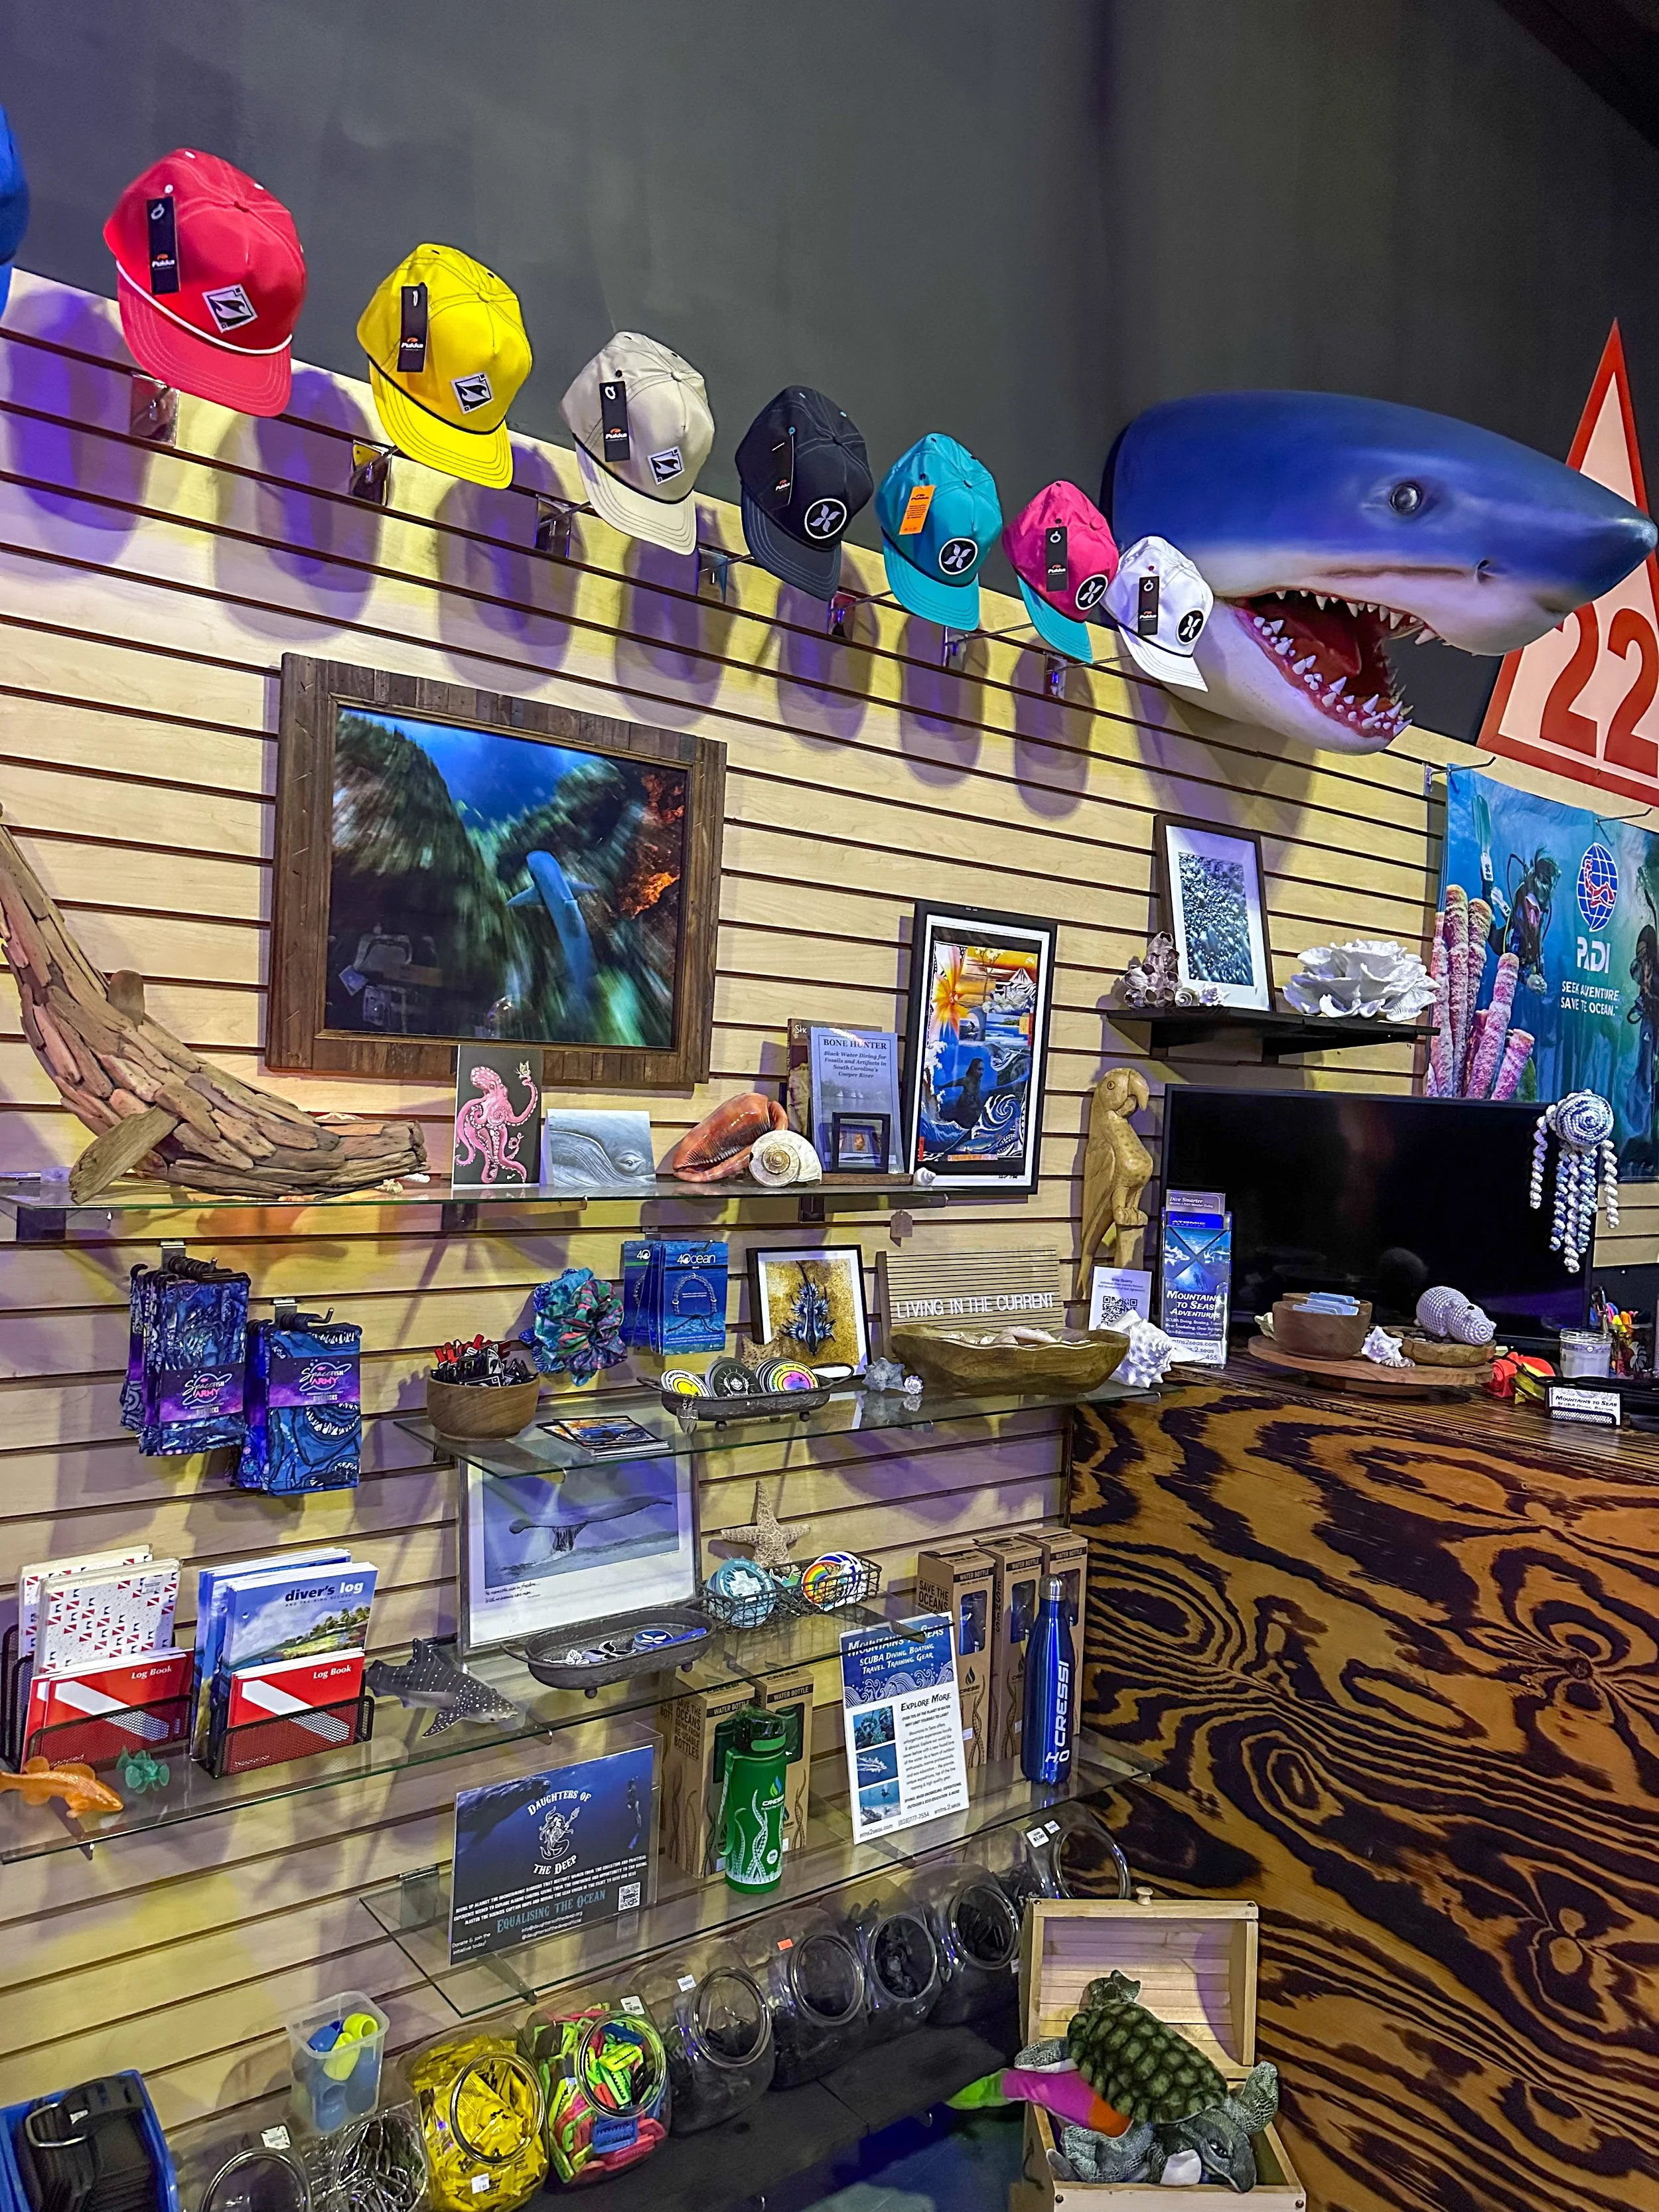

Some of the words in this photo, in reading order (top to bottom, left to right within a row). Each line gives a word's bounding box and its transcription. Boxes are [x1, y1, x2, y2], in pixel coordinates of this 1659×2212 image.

[1577, 936, 1611, 974] PADI
[1561, 980, 1579, 994] SEEK
[1580, 984, 1620, 1001] AVENTURE.
[1561, 996, 1579, 1010] SAVE
[850, 1040, 887, 1050] HUNTER
[897, 1299, 944, 1319] LIVING
[950, 1298, 964, 1315] IN
[966, 1296, 993, 1313] THE
[996, 1292, 1054, 1311] CURRENT
[1190, 1301, 1215, 1311] SEAS
[311, 1376, 340, 1386] ARMY
[194, 1387, 221, 1398] ARMY
[1555, 1395, 1591, 1404] MOUNTAINS
[1069, 1548, 1083, 1557] BOTTLE
[1025, 1558, 1040, 1567] BOTTLE
[974, 1569, 989, 1578] BOTTLE
[285, 1585, 335, 1601] diver's
[339, 1582, 364, 1594] log
[919, 1580, 935, 1595] SAVE
[936, 1587, 948, 1601] THE
[918, 1591, 948, 1611] OCEANS
[860, 1654, 884, 1666] SCUBA
[916, 1652, 934, 1662] GEAR
[131, 1671, 148, 1680] Log
[150, 1665, 173, 1676] Book
[313, 1670, 328, 1680] Log
[330, 1664, 352, 1676] Book
[766, 1670, 799, 1680] CRESSI
[773, 1690, 790, 1701] WATER
[791, 1686, 809, 1697] BOTTLE
[677, 1698, 689, 1710] SAVE
[691, 1704, 701, 1718] THE
[713, 1705, 731, 1716] WATER
[731, 1700, 750, 1712] BOTTLE
[901, 1698, 930, 1712] EXPLORE
[1054, 1660, 1069, 1747] CRESSI
[676, 1706, 701, 1731] OCEANS
[675, 1727, 700, 1748] RE-USABLE
[674, 1735, 699, 1760] BOTTLES
[527, 1790, 579, 1816] DAUGHTERS
[579, 1792, 592, 1802] OF
[533, 1864, 552, 1875] THE
[553, 1854, 577, 1875] DEEP
[497, 1905, 549, 1933] EQUALISING
[555, 1899, 573, 1910] THE
[577, 1889, 606, 1908] OCEAN
[452, 1939, 469, 1949] Donate
[453, 1945, 472, 1955] initiative
[472, 1940, 487, 1951] today!
